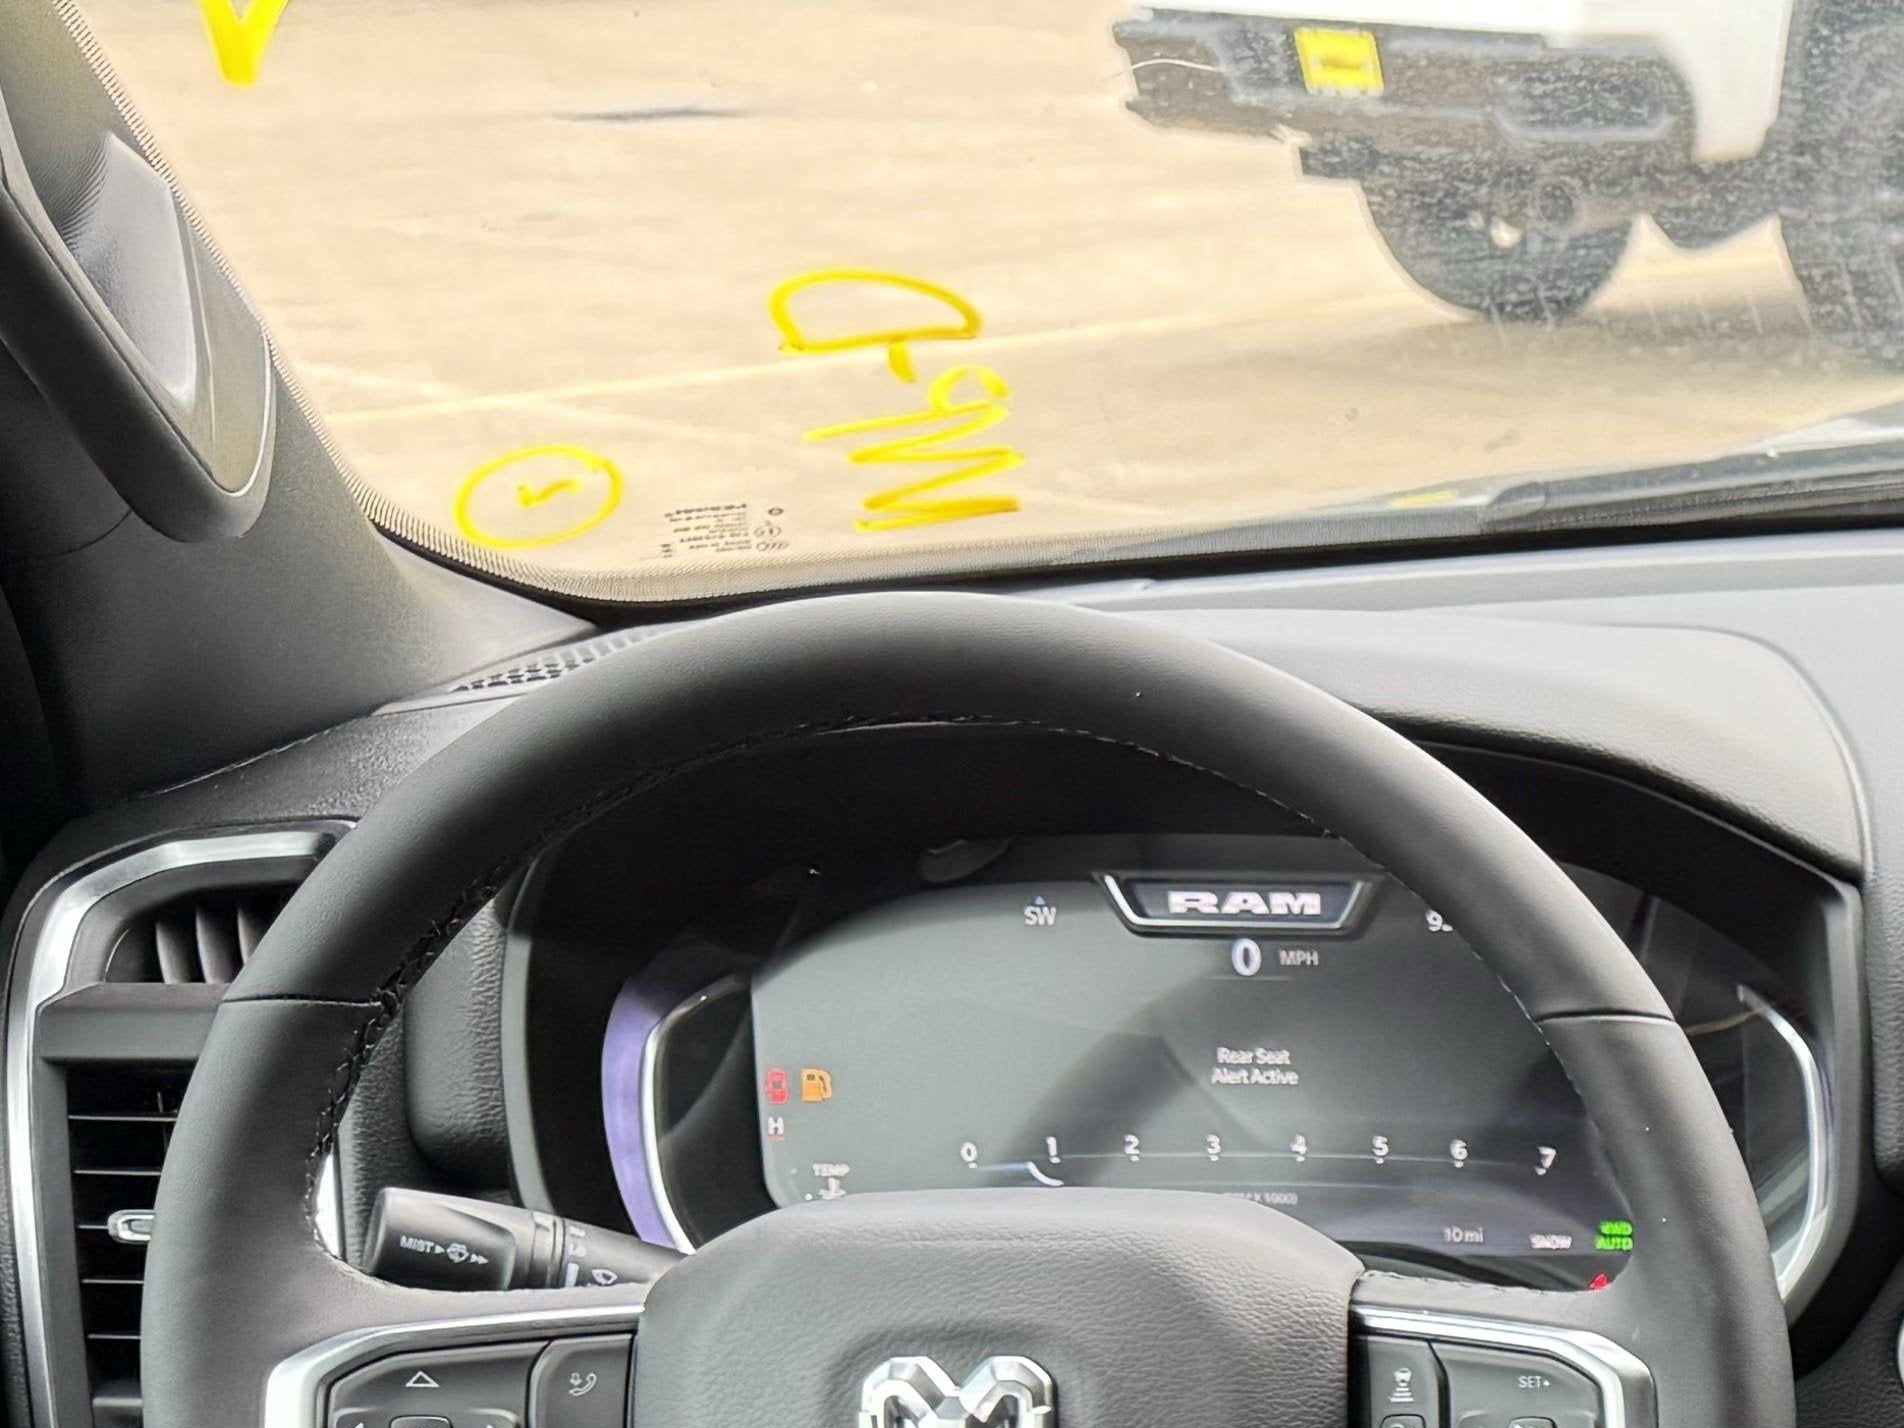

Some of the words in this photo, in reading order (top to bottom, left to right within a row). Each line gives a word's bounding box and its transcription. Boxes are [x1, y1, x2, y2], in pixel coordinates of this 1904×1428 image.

[1168, 891, 1321, 915] RAM
[1024, 906, 1057, 925] SW
[1426, 909, 1453, 932] 9
[1231, 937, 1262, 977] 0
[1279, 950, 1319, 967] MPH
[1216, 1047, 1253, 1065] Rear
[1255, 1048, 1291, 1065] Seat
[1211, 1068, 1249, 1085] Alert
[1250, 1068, 1299, 1085] Active
[767, 1117, 784, 1135] H
[960, 1141, 978, 1162] 0
[1124, 1134, 1140, 1154] 2
[1207, 1134, 1221, 1154] 3
[1290, 1135, 1307, 1155] 4
[1372, 1135, 1389, 1156] 5
[1450, 1139, 1468, 1160] 6
[1539, 1146, 1556, 1168] 7
[812, 1163, 850, 1177] TEMP
[1443, 1228, 1464, 1243] 10
[1465, 1226, 1484, 1243] mi
[1595, 1235, 1633, 1250] AUTO
[400, 1235, 435, 1254] MIST
